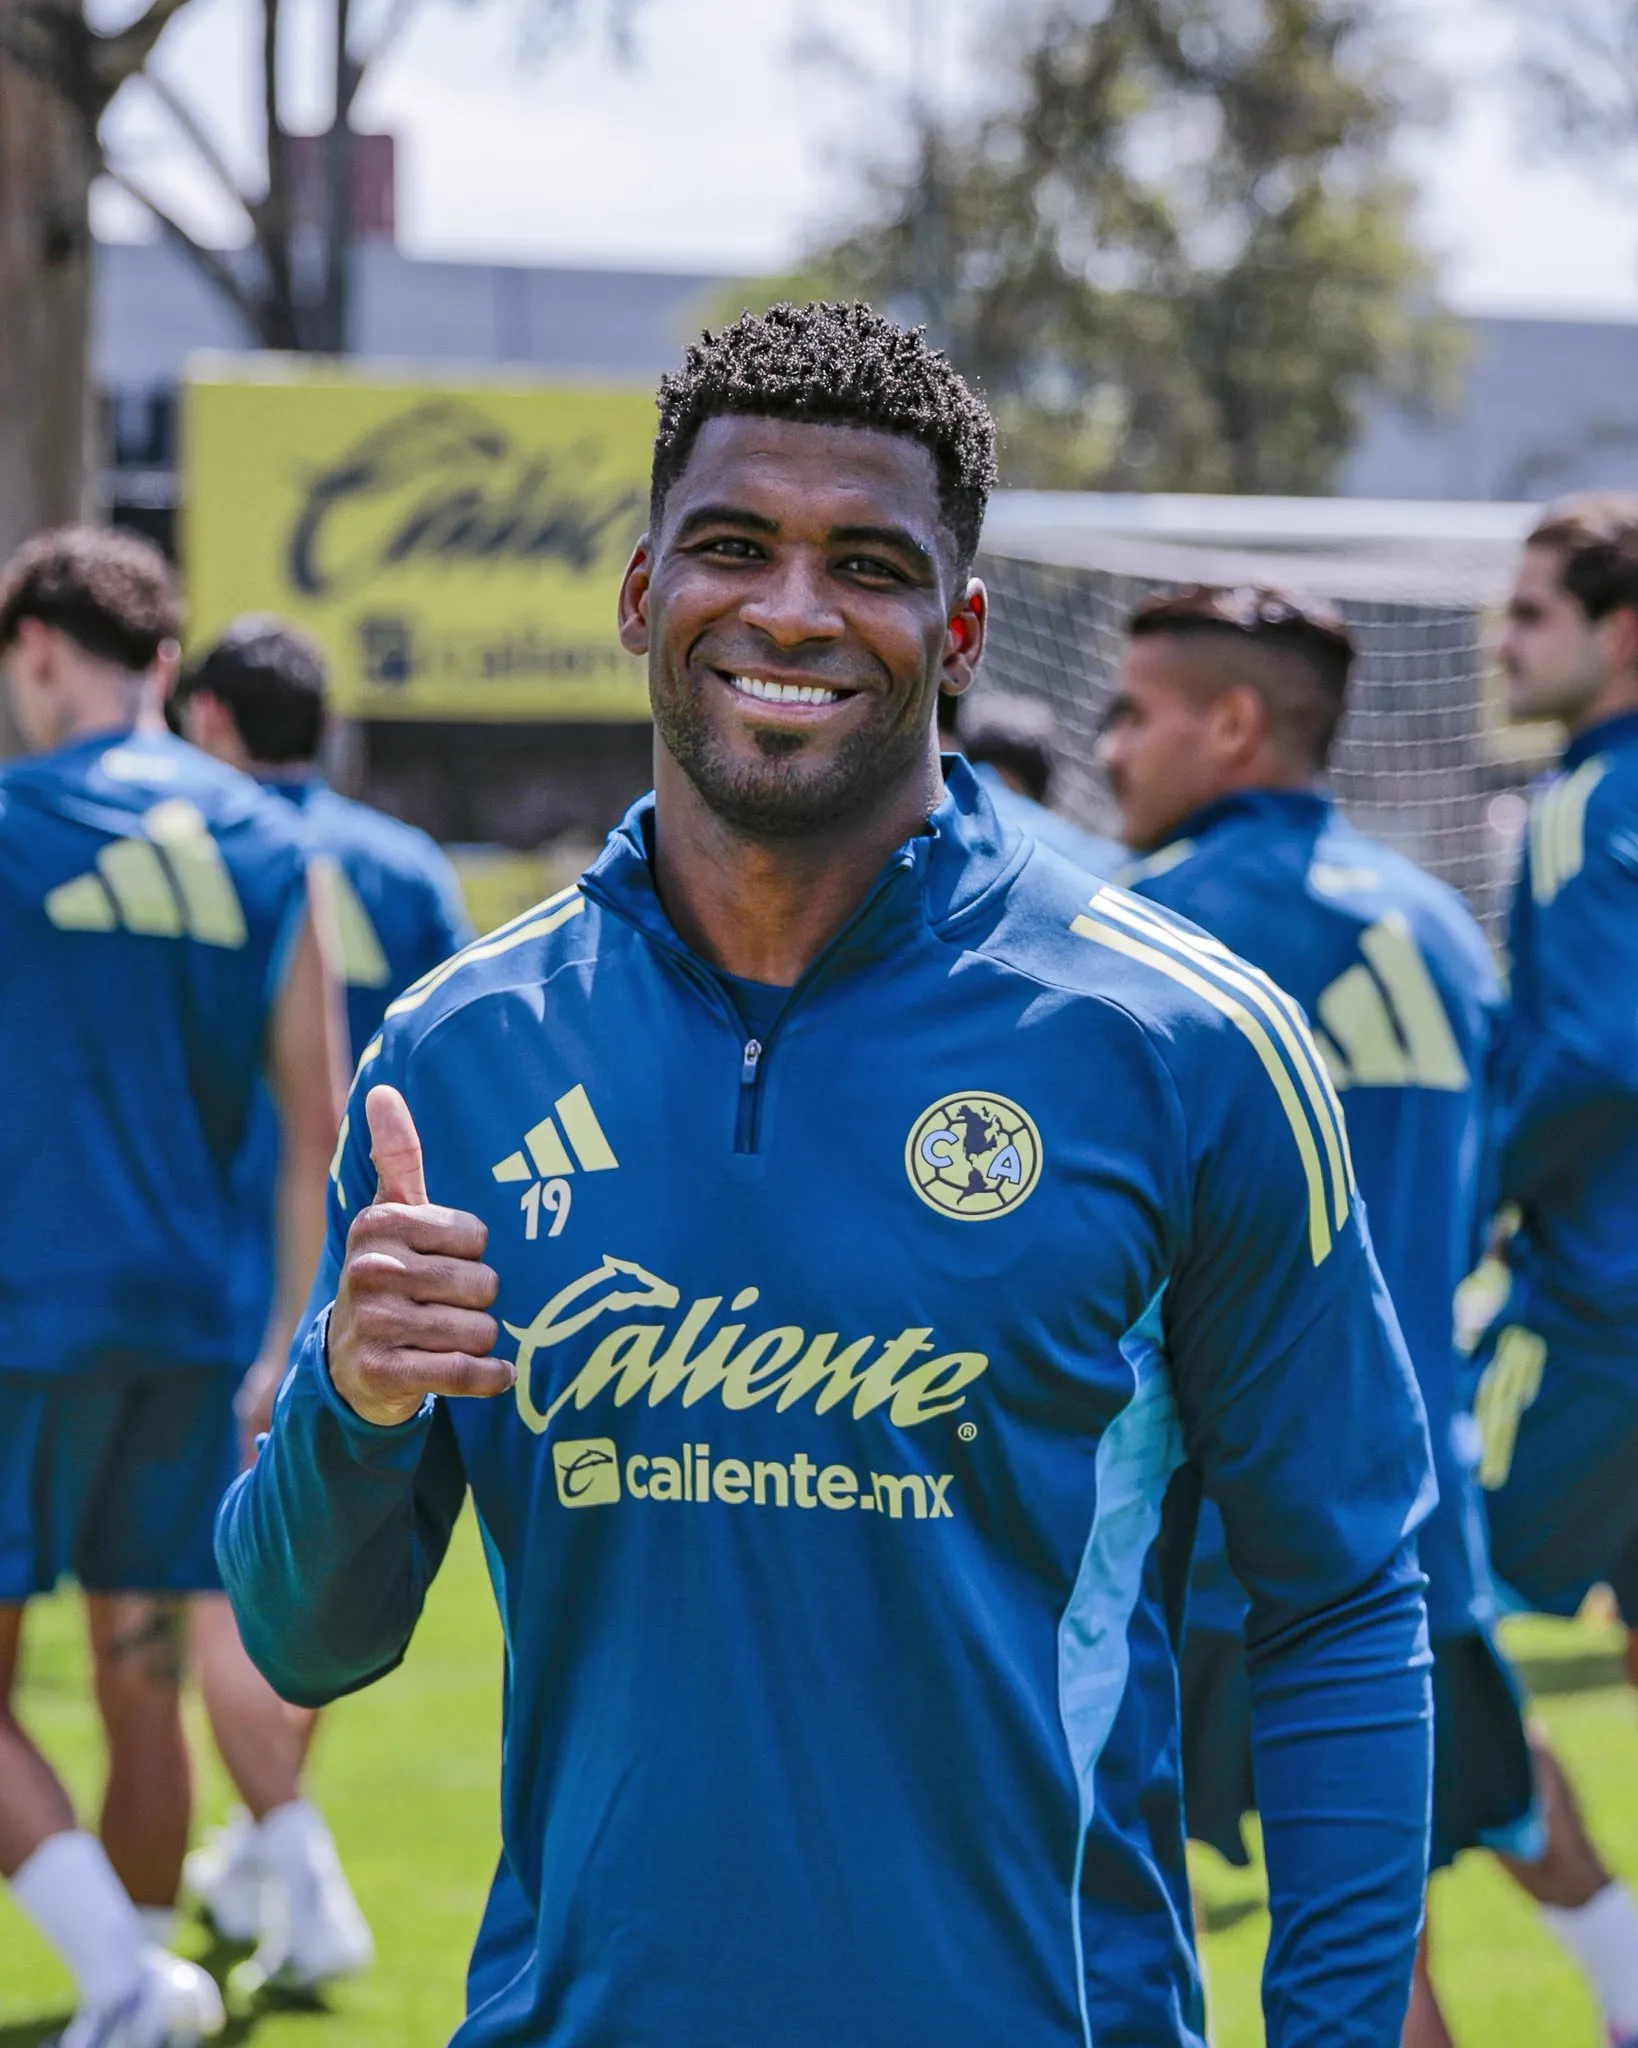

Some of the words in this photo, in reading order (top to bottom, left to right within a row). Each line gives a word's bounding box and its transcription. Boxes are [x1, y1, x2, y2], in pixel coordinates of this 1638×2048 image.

[519, 1177, 573, 1240] 19
[501, 1253, 990, 1435] Caliente
[625, 1442, 955, 1519] caliente.mx
